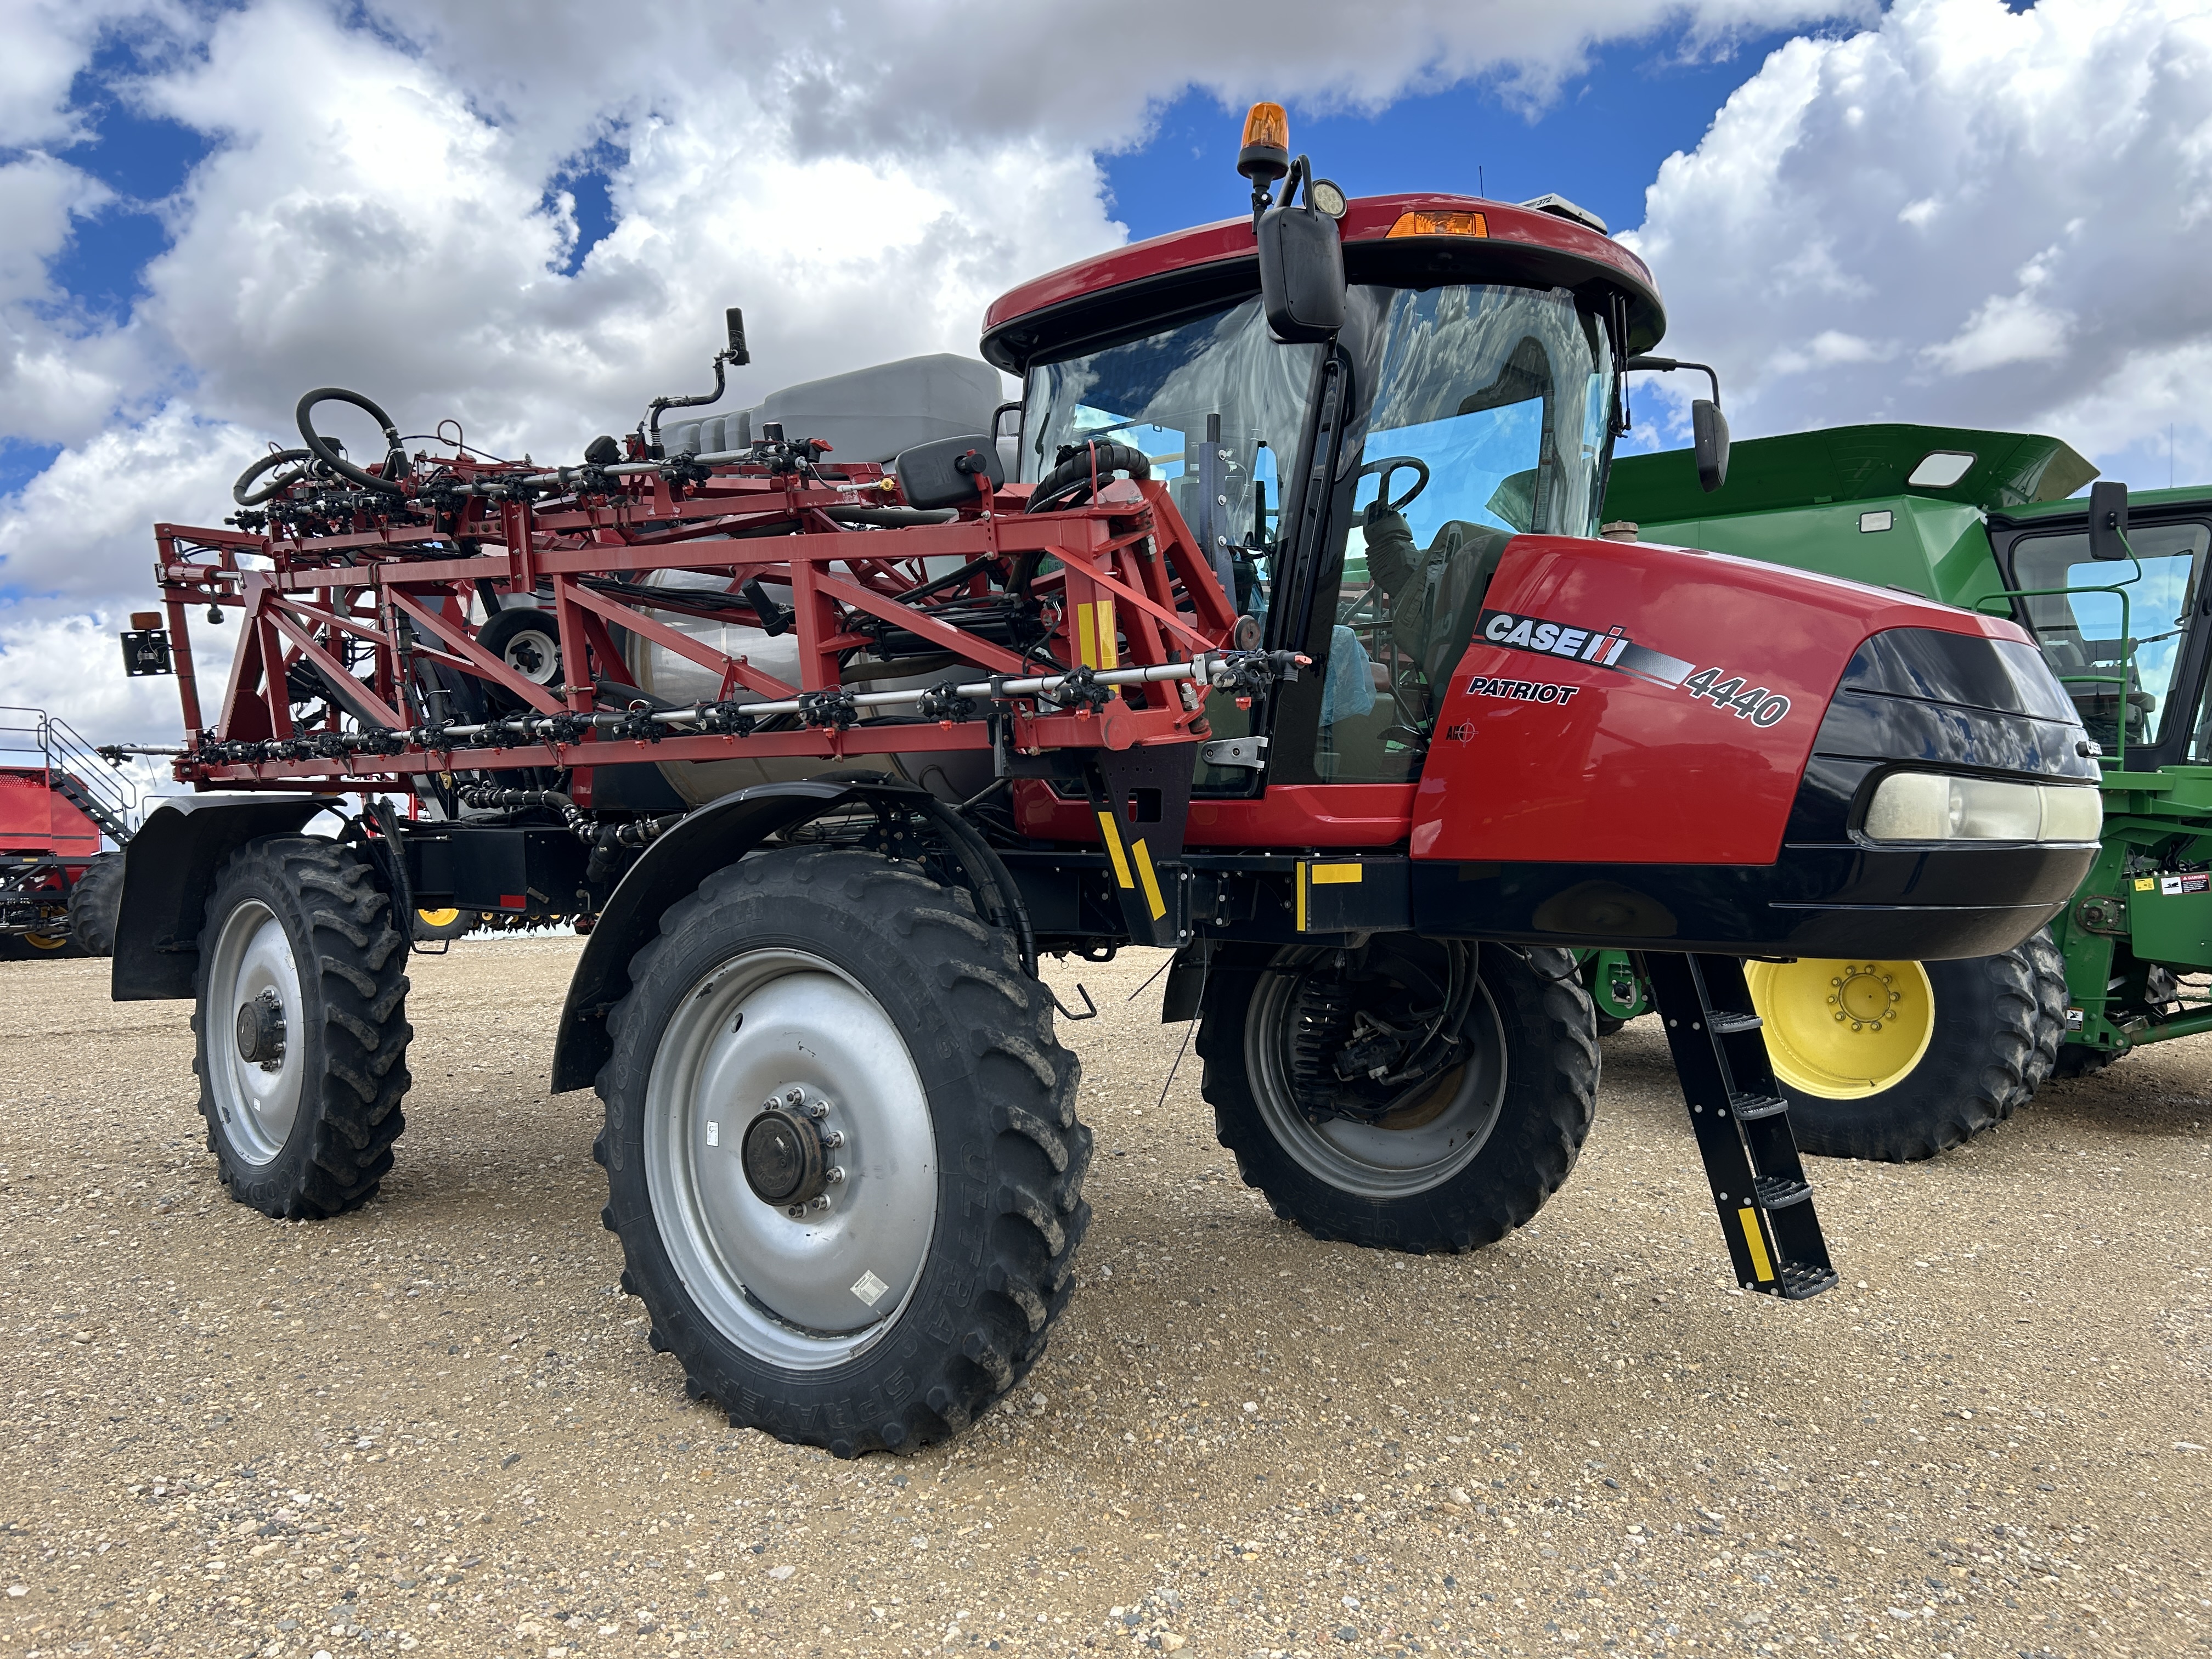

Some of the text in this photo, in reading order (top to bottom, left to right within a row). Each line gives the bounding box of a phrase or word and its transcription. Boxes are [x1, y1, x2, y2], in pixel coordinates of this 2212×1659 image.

[1537, 196, 1552, 206] 372
[1467, 676, 1579, 705] PATRIOT
[1684, 667, 1791, 728] 4440
[611, 890, 765, 1171] GOODYEAR
[927, 1141, 988, 1345] ULTRA
[714, 1365, 915, 1431] SPRAYER
